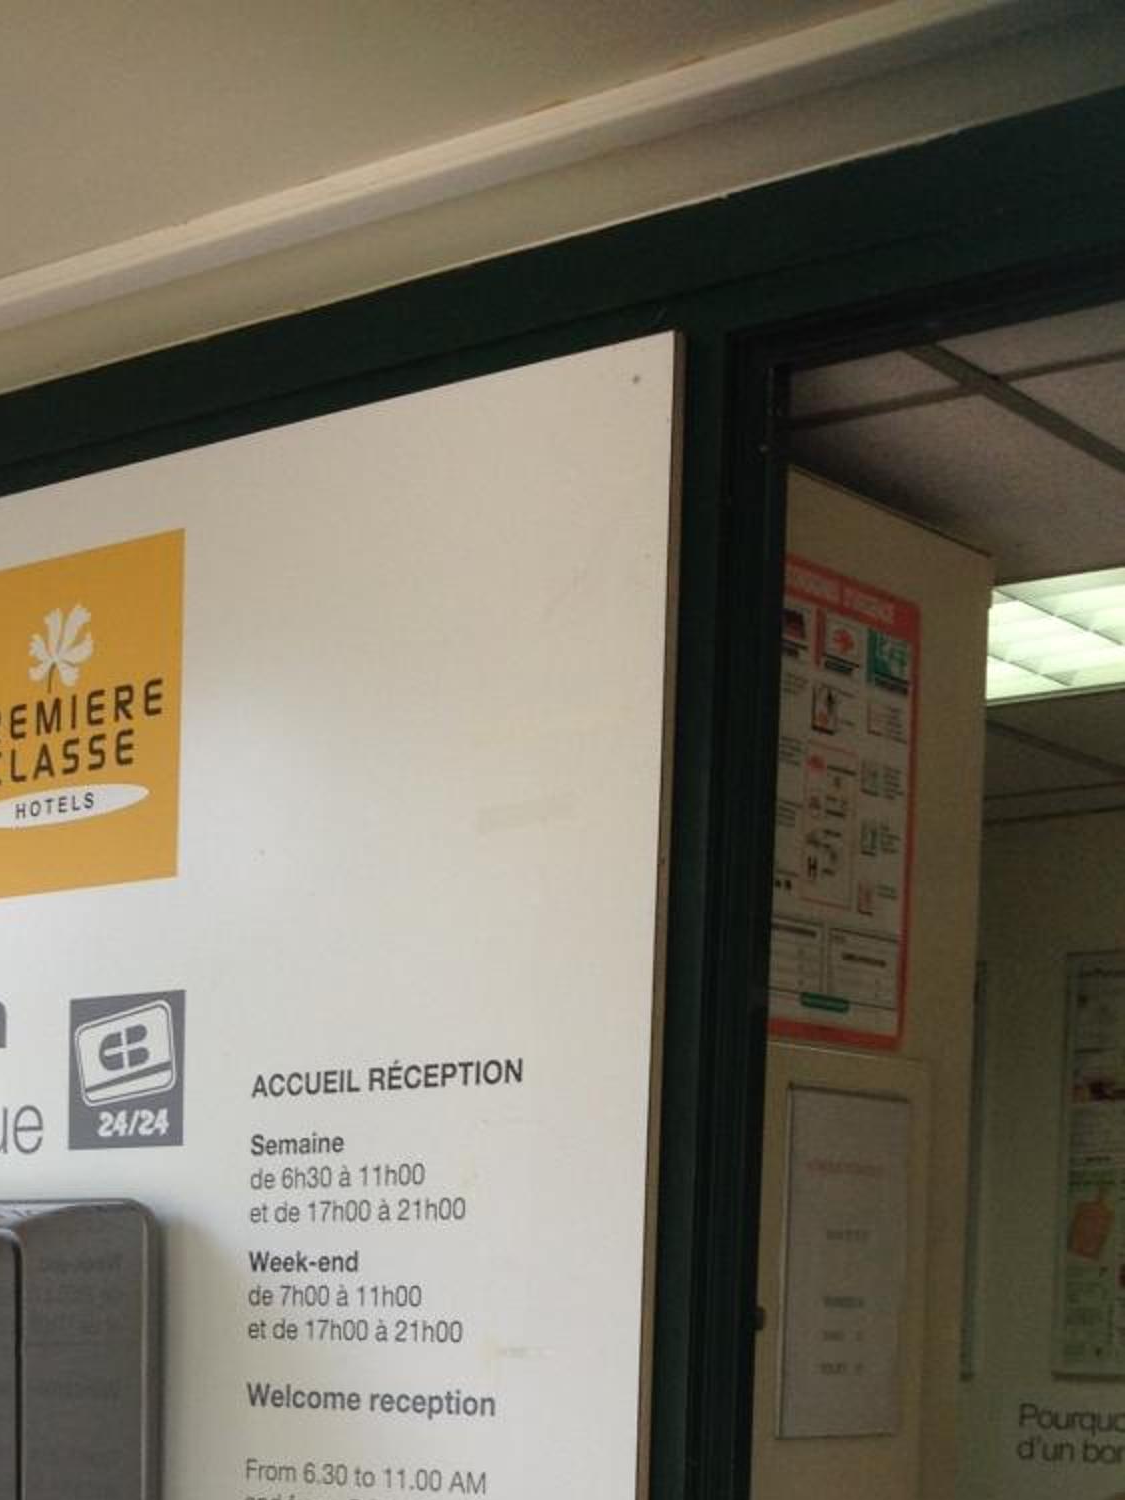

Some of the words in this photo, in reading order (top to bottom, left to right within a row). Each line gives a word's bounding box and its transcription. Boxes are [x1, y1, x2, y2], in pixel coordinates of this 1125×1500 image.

[14, 792, 95, 820] HOTELS
[251, 1069, 360, 1099] ACCUEIL
[368, 1058, 524, 1092] RÉCEPTION
[98, 1109, 170, 1137] 24/24
[250, 1132, 344, 1156] Semaine
[250, 1169, 275, 1189] de
[282, 1167, 332, 1188] 6h30
[339, 1166, 351, 1187] à
[360, 1163, 425, 1186] 11h00
[250, 1204, 268, 1223] et
[274, 1202, 300, 1222] de
[309, 1199, 371, 1222] 17h00
[378, 1199, 390, 1221] à
[398, 1197, 466, 1221] 21h00
[249, 1250, 359, 1273] Week-end
[248, 1286, 273, 1306] de
[280, 1286, 329, 1306] 7h00
[336, 1285, 349, 1306] à
[358, 1286, 422, 1307] 11h00
[248, 1320, 266, 1340] et
[273, 1319, 297, 1340] de
[306, 1319, 368, 1341] 17h00
[375, 1319, 388, 1342] à
[395, 1320, 463, 1343] 21h00
[247, 1382, 361, 1411] Welcome
[370, 1389, 496, 1420] reception
[245, 1458, 296, 1484] From
[302, 1462, 348, 1486] 6.30
[354, 1466, 375, 1488] to
[382, 1468, 442, 1492] 11.00
[449, 1471, 487, 1495] AM
